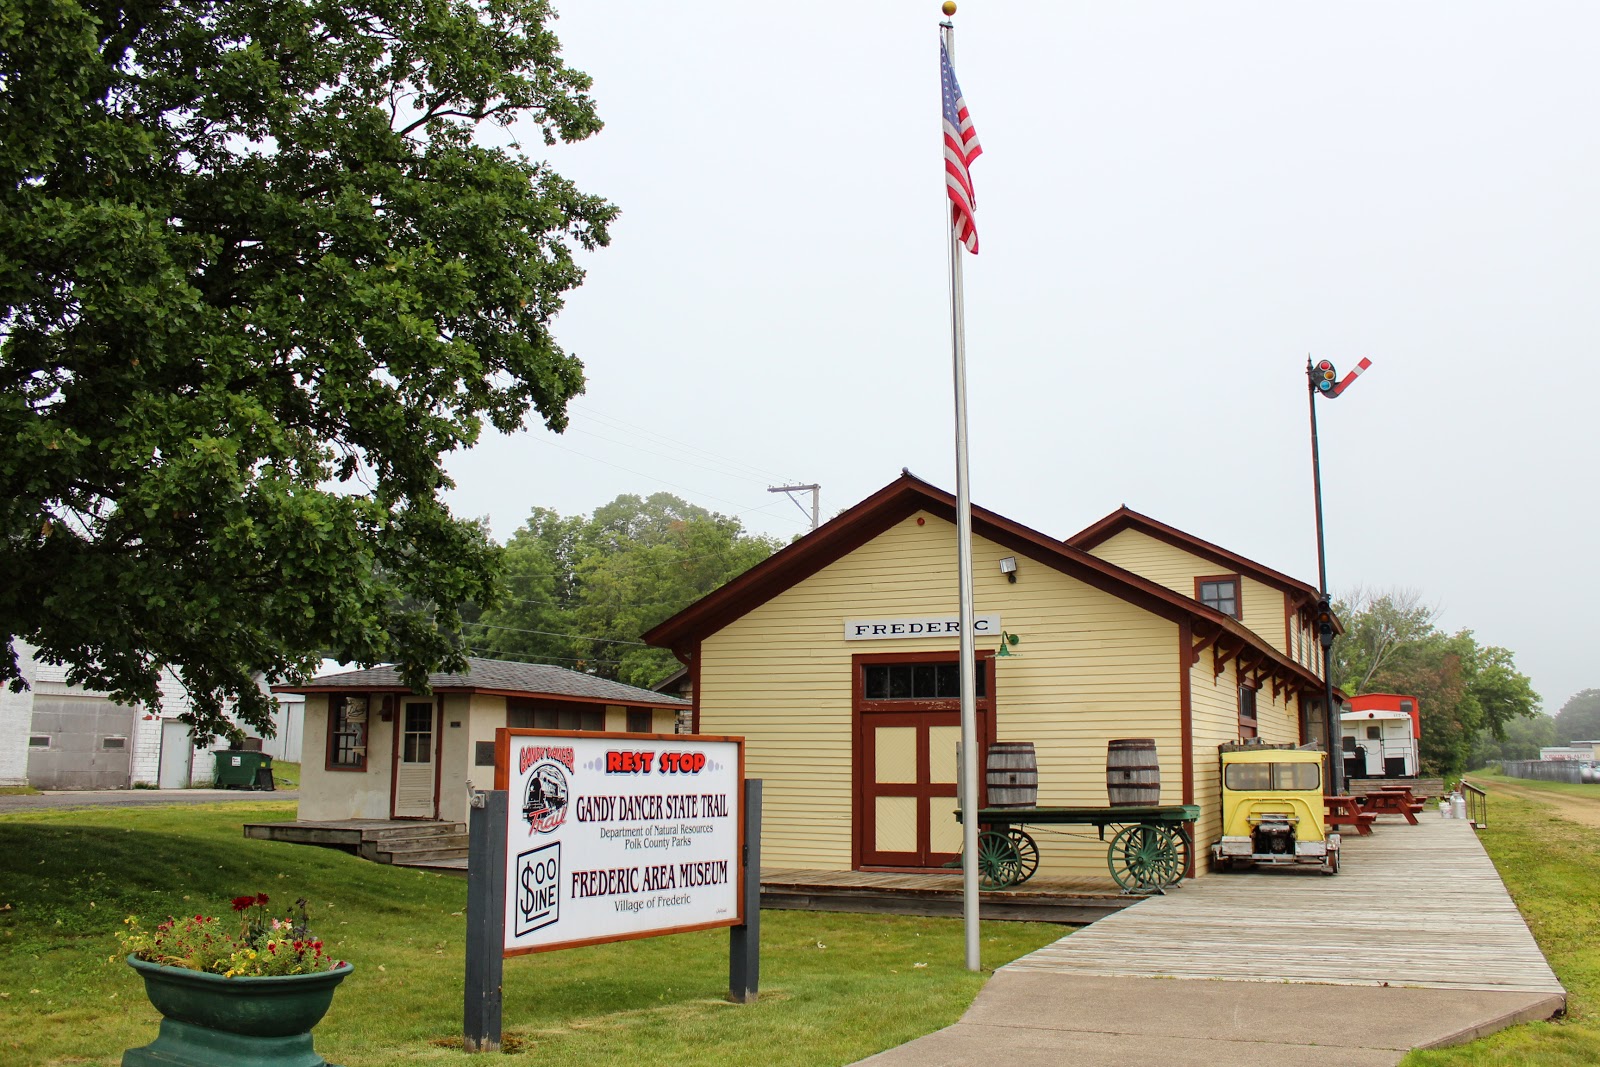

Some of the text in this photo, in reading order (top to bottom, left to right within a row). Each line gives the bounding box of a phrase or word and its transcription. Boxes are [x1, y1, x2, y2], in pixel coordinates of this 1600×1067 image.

[855, 620, 989, 635] FREDERC
[520, 747, 574, 775] GANDY DANCER
[606, 751, 706, 774] REST STOP
[576, 794, 729, 822] GANDY DANCER STATE TRAIL
[528, 804, 568, 837] Trail
[600, 824, 714, 841] Department of Natural Resources
[625, 836, 692, 851] Polk County Parks
[571, 860, 729, 899] FREDERIC AREA MUSEUM
[614, 893, 691, 913] Village of Frederic
